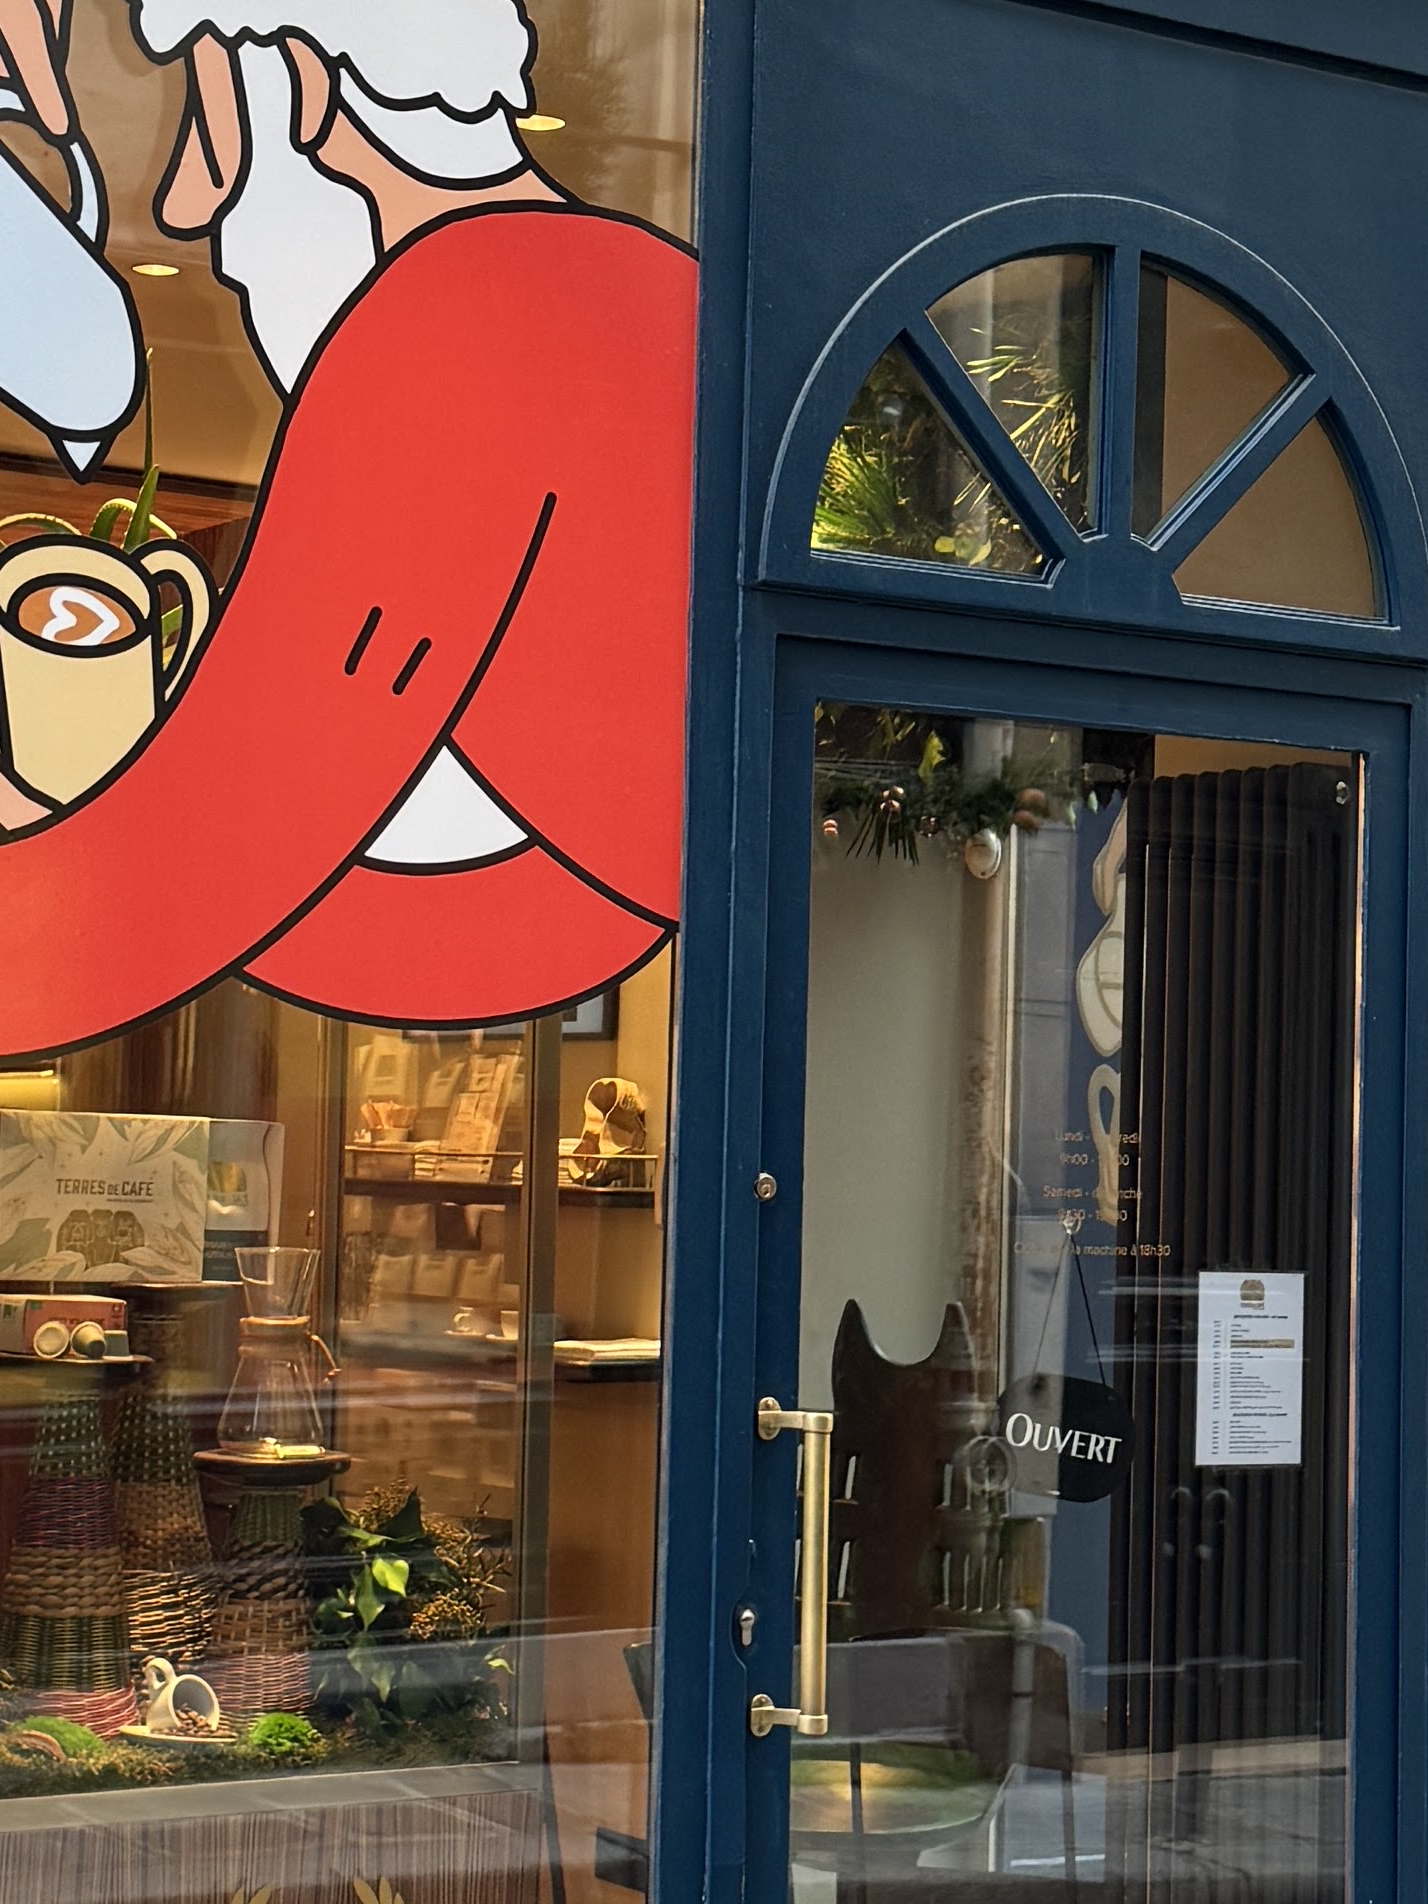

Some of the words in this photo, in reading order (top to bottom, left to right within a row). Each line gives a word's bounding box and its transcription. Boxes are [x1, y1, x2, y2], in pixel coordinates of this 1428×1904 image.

[56, 1178, 105, 1196] TERRES
[107, 1183, 120, 1196] DE
[122, 1176, 155, 1197] CAFÉ
